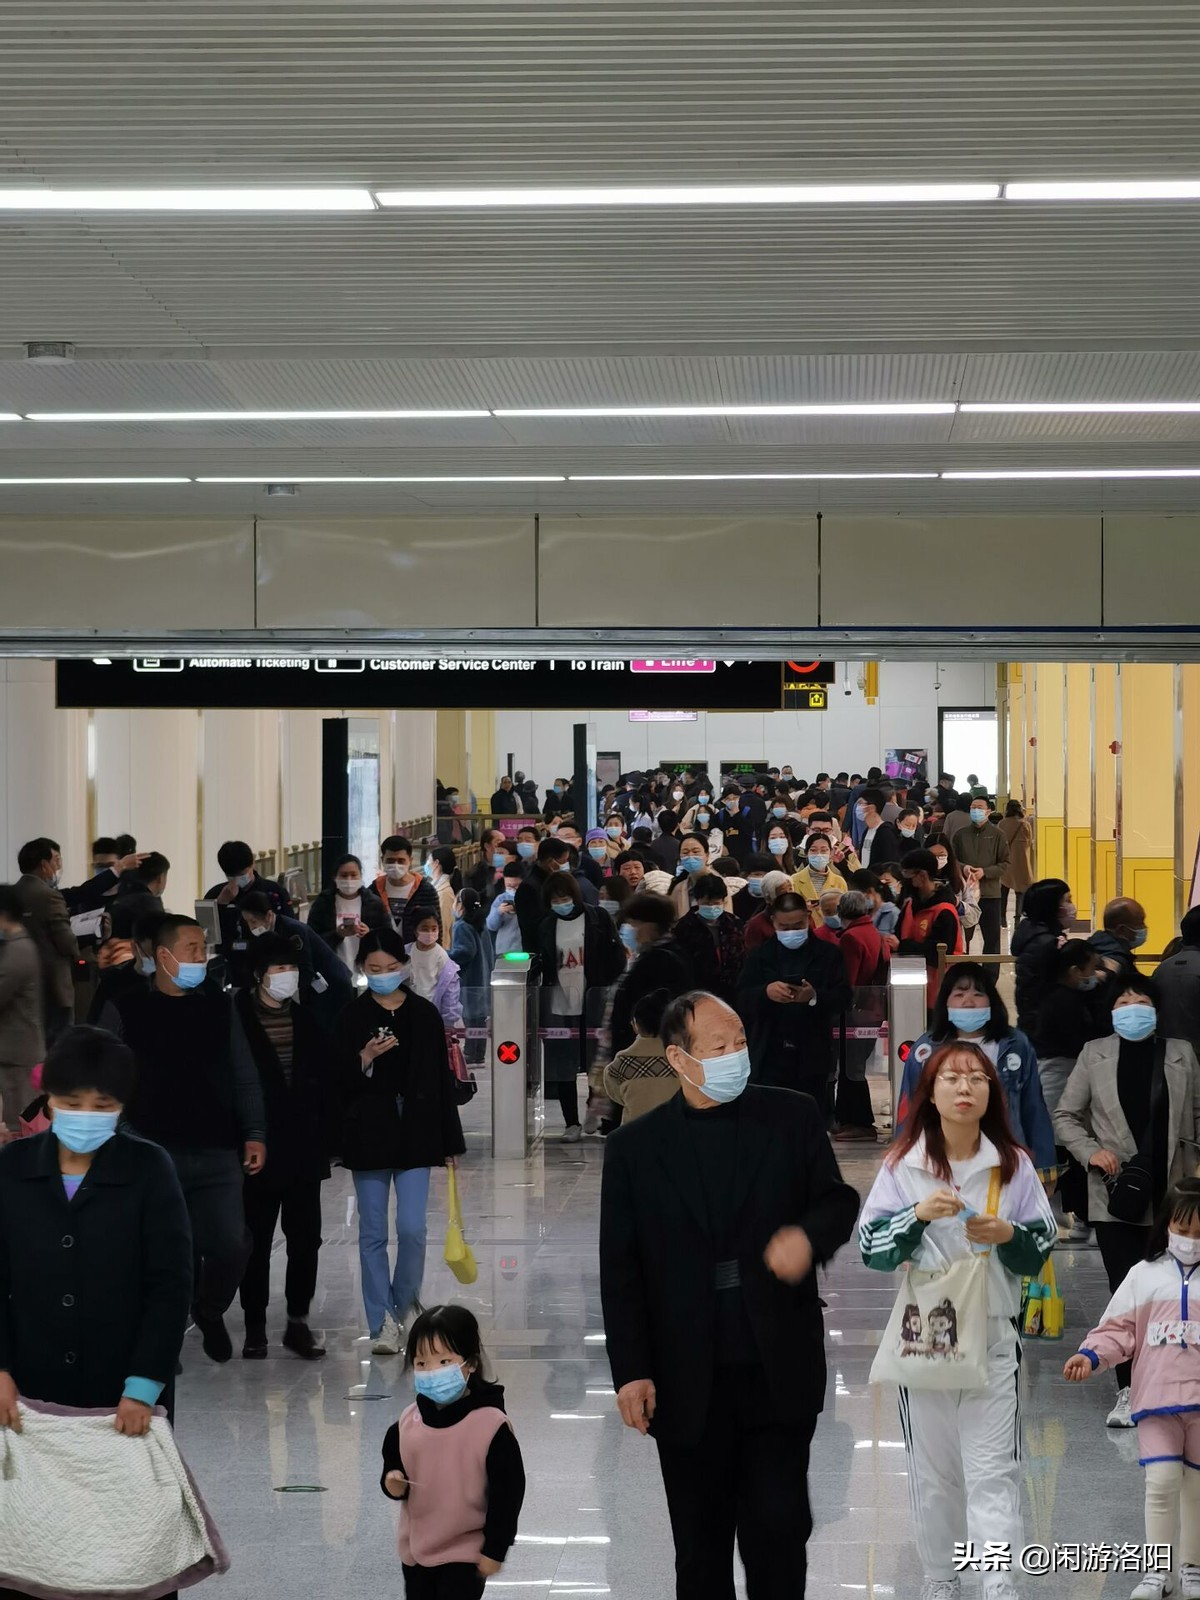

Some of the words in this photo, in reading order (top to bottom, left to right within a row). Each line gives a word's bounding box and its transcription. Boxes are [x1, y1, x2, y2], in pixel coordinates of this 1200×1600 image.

[189, 658, 252, 668] Automatic
[256, 658, 310, 670] Ticketing
[369, 659, 436, 671] Customer
[438, 659, 489, 671] Service
[491, 659, 537, 671] Center
[571, 659, 587, 671] To
[590, 659, 625, 671] Train
